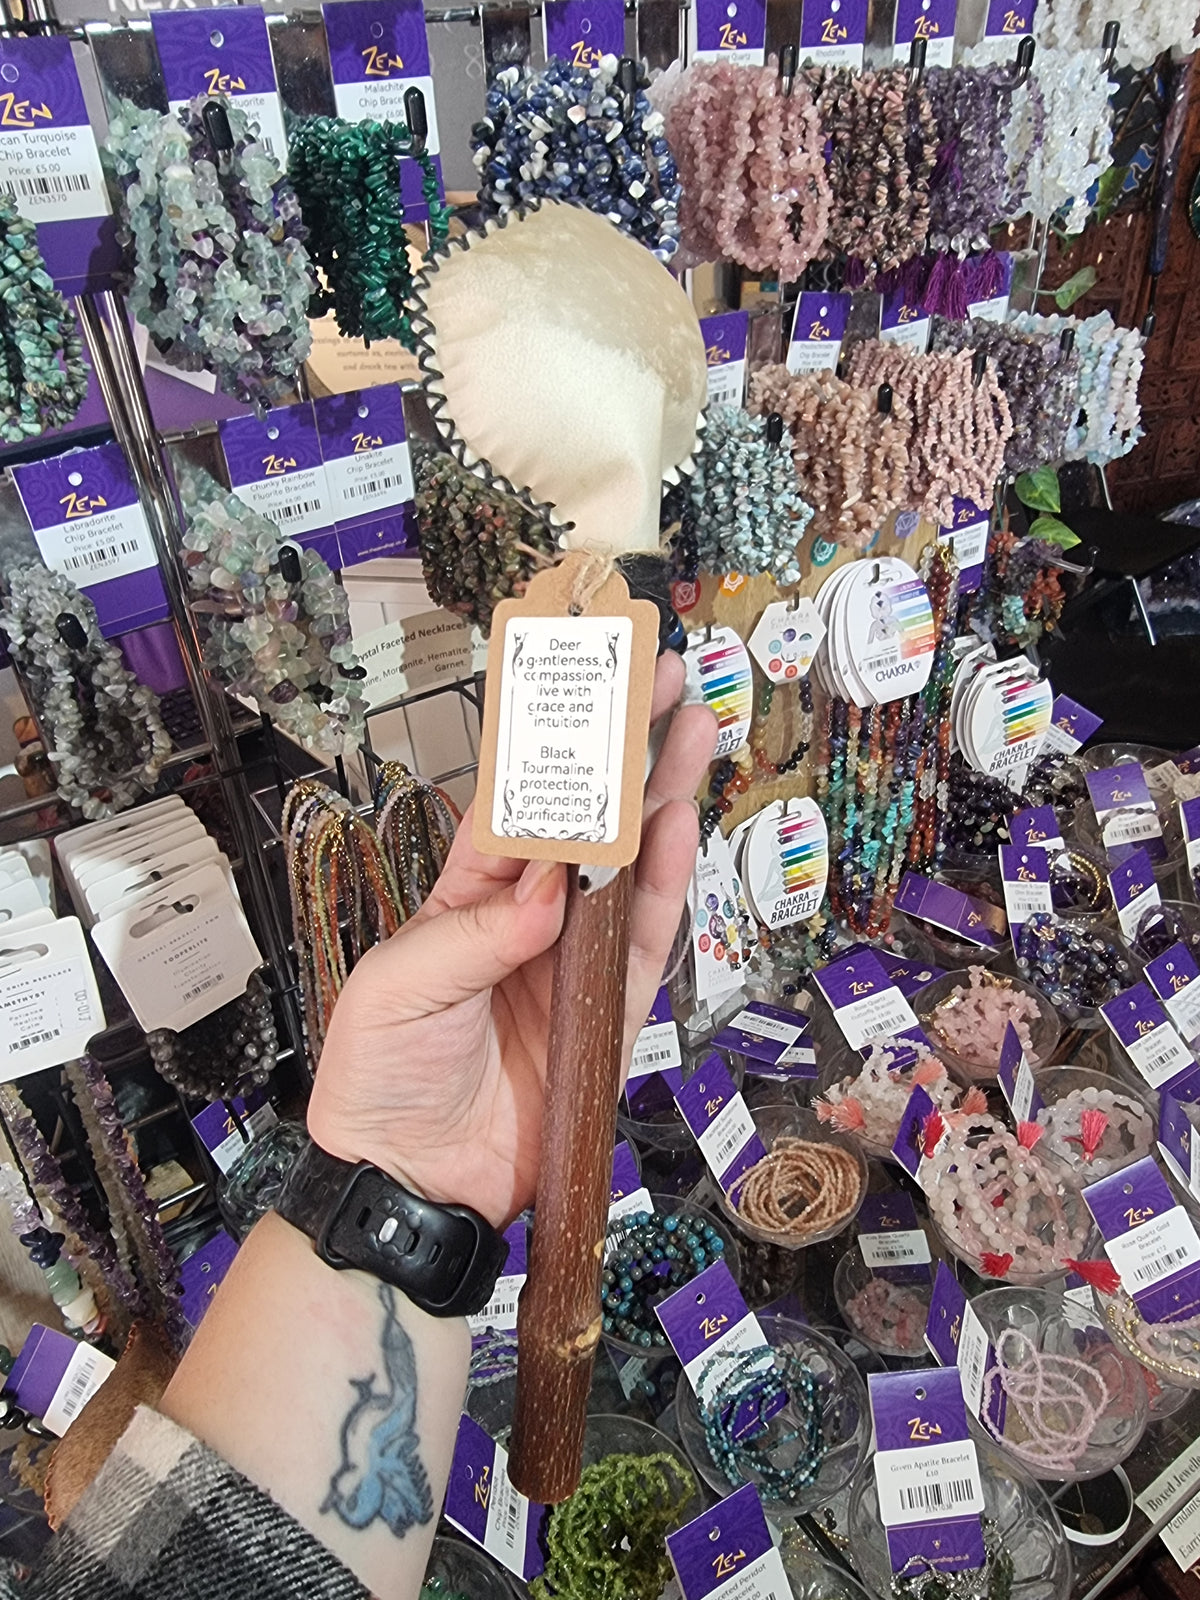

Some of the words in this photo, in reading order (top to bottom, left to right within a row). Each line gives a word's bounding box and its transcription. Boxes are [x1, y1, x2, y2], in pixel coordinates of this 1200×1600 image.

[821, 18, 847, 43] ZEN
[914, 15, 939, 40] ZEN
[1002, 10, 1025, 33] ZEN
[718, 23, 747, 49] ZEN
[362, 46, 404, 76] ZEN
[571, 40, 603, 68] ZEN
[204, 68, 246, 97] ZEN
[364, 82, 404, 93] Malachite
[0, 92, 53, 127] ZEN
[358, 97, 378, 108] Chip
[380, 95, 403, 106] Brace
[22, 131, 77, 145] Turquoise
[0, 150, 23, 161] Chip
[26, 147, 72, 159] Bracelet
[808, 321, 830, 341] ZEN
[706, 345, 730, 365] ZEN
[351, 432, 383, 452] ZEN
[262, 455, 296, 475] ZEN
[355, 451, 383, 462] Unakite
[365, 457, 393, 469] Bracelet
[250, 480, 279, 492] Chunky
[281, 471, 315, 483] Rainbow
[253, 490, 283, 501] Fluorite
[285, 480, 316, 493] Bracelet
[59, 492, 107, 518] ZEN
[63, 514, 115, 533] Labradorite
[65, 534, 85, 545] Chip
[87, 523, 124, 539] Bracelet
[380, 630, 416, 652] Faceted
[418, 621, 468, 638] Necklaces
[549, 638, 582, 651] Deer
[382, 656, 427, 678] Morganite,
[428, 646, 472, 662] Hematite,
[434, 659, 468, 673] Garnet.
[526, 654, 602, 670] gentleness,
[875, 662, 914, 682] CHAKRA
[524, 668, 606, 685] compassion,
[536, 684, 559, 697] live
[562, 684, 592, 697] with
[527, 702, 565, 716] grace
[568, 700, 594, 713] and
[534, 715, 590, 729] intuition
[540, 745, 576, 760] Black
[989, 746, 1037, 772] BRACELET
[993, 742, 1028, 761] CHAKRA
[521, 760, 594, 776] Tourmaline
[519, 778, 593, 793] protection,
[522, 794, 592, 811] grounding
[516, 808, 592, 823] purification
[1025, 828, 1047, 843] ZEN
[1017, 866, 1037, 882] ZEN
[770, 898, 819, 924] BRACELET
[774, 892, 809, 910] CHAKRA
[849, 981, 874, 995] ZEN
[1169, 975, 1190, 992] ZEN
[0, 991, 45, 1009] AMETHYST
[13, 1015, 43, 1027] Healing
[20, 1022, 40, 1032] Calm
[1134, 1020, 1155, 1036] ZEN
[704, 1095, 723, 1117] ZEN
[222, 1109, 250, 1134] ZN
[1124, 1207, 1154, 1226] ZEN
[699, 1314, 728, 1339] ZEN
[726, 1327, 748, 1347] Apatite
[907, 1417, 942, 1441] ZEN
[890, 1463, 913, 1472] Green
[914, 1459, 940, 1471] Apatite
[941, 1454, 970, 1465] Bracelet
[926, 1470, 939, 1478] £10
[475, 1466, 490, 1509] ZEN
[491, 1476, 499, 1511] Peridot
[498, 1468, 506, 1507] Bracelet
[1146, 1481, 1177, 1512] Boxed
[495, 1509, 503, 1531] Chip
[1166, 1496, 1200, 1535] Pendants
[712, 1549, 746, 1578] ZEN
[712, 1583, 738, 1600] ceted
[739, 1563, 766, 1585] Peridot
